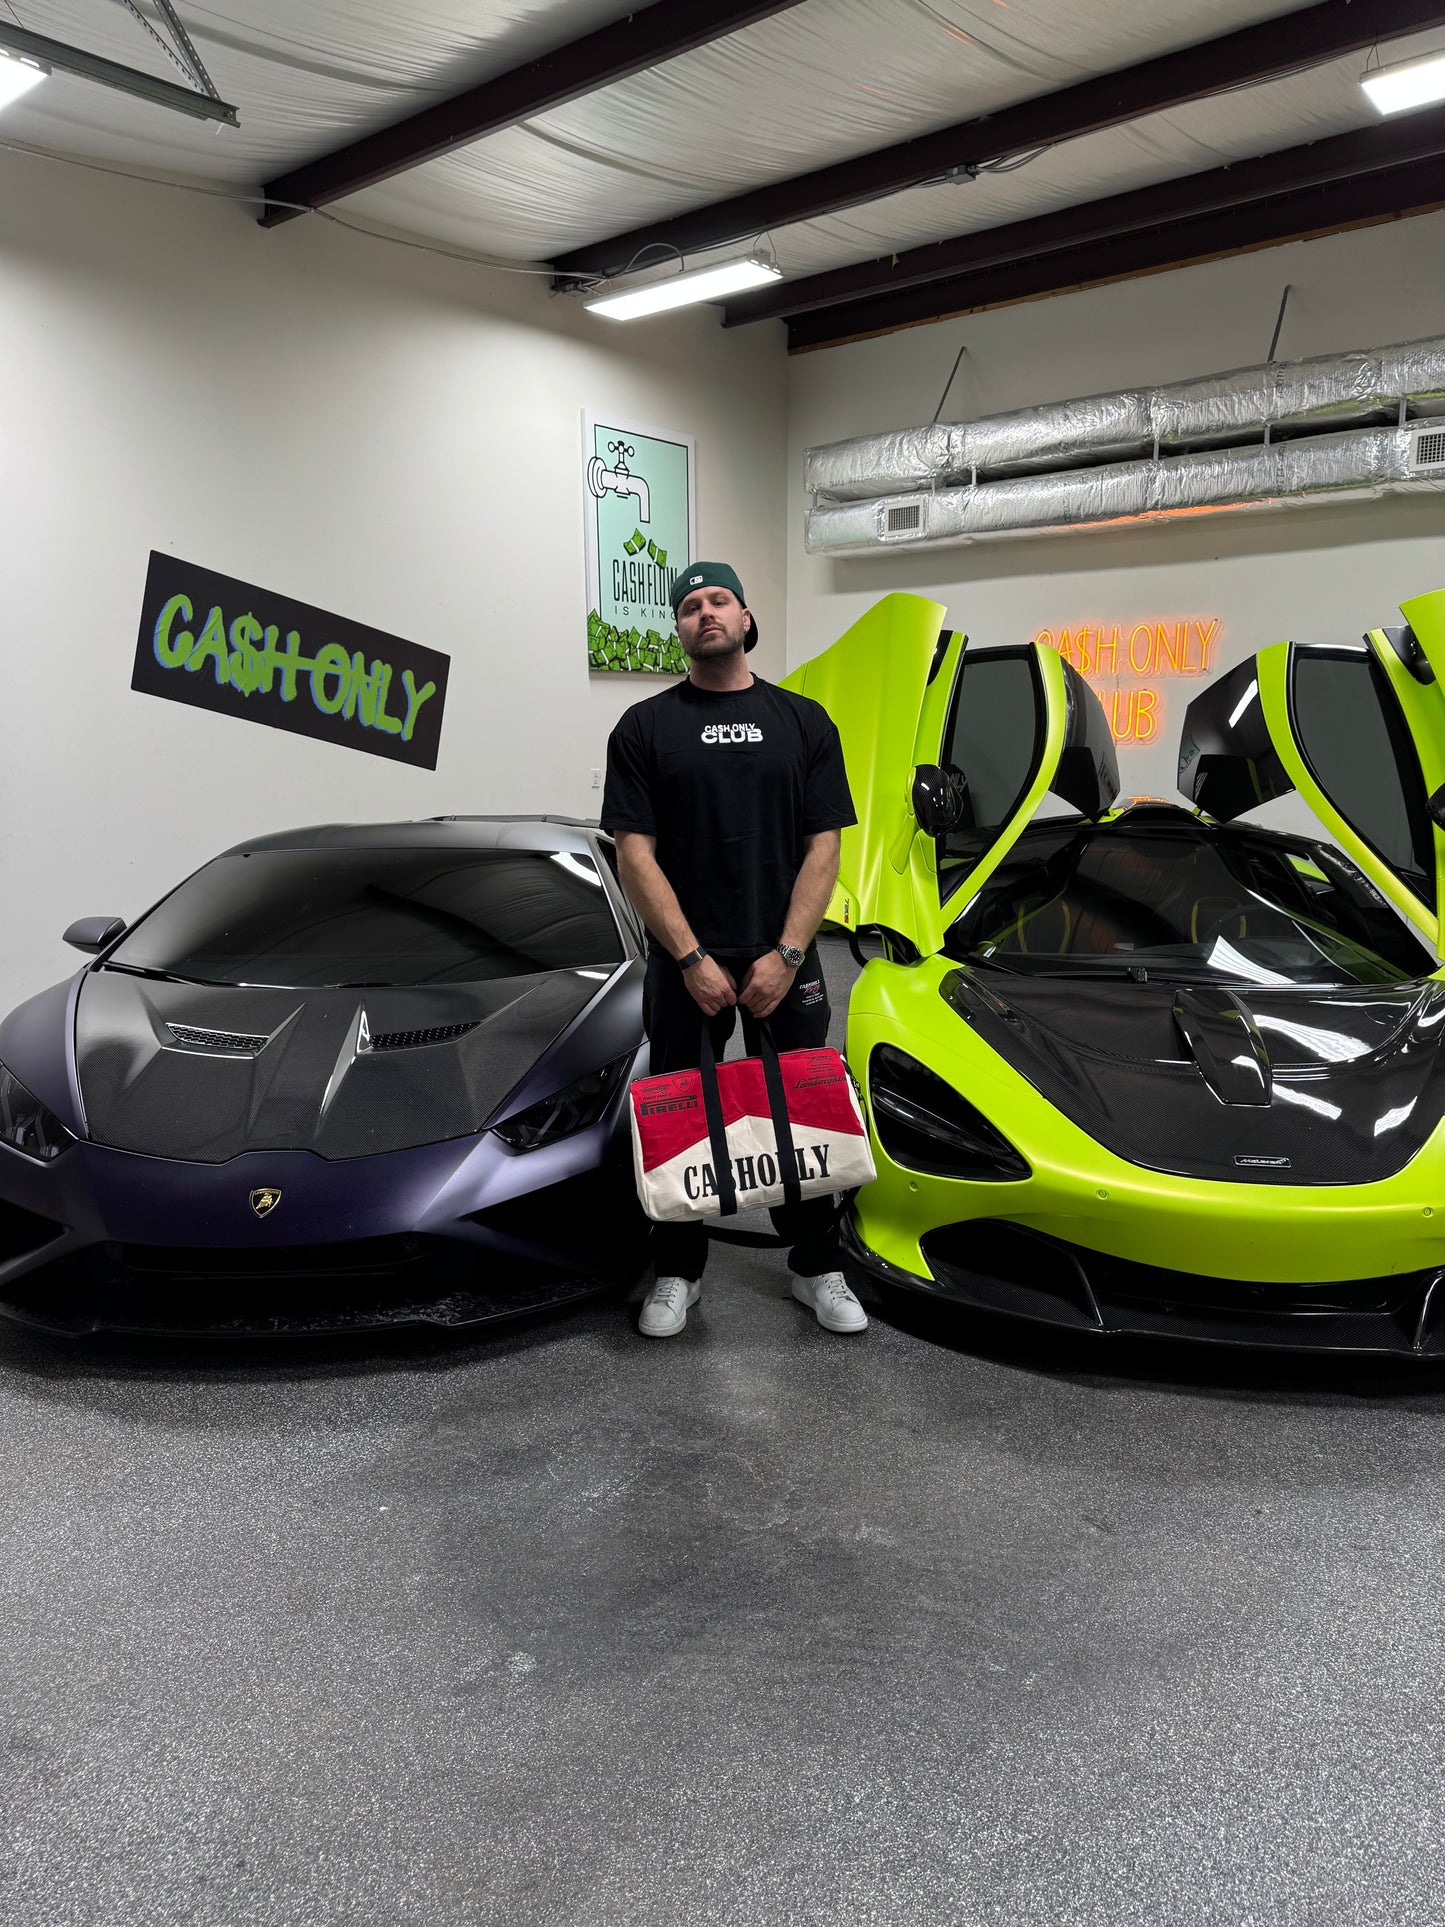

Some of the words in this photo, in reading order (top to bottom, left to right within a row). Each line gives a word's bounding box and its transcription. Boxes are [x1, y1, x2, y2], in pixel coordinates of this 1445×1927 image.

[613, 559, 645, 604] CASH
[614, 605, 629, 616] IS
[1129, 620, 1217, 674] ONLY
[310, 643, 437, 742] ONLY
[701, 728, 763, 744] CLUB
[704, 724, 730, 733] CASH
[732, 723, 755, 732] ONLY
[641, 1095, 698, 1116] PIRELLI
[684, 1144, 830, 1200] CAHOLY
